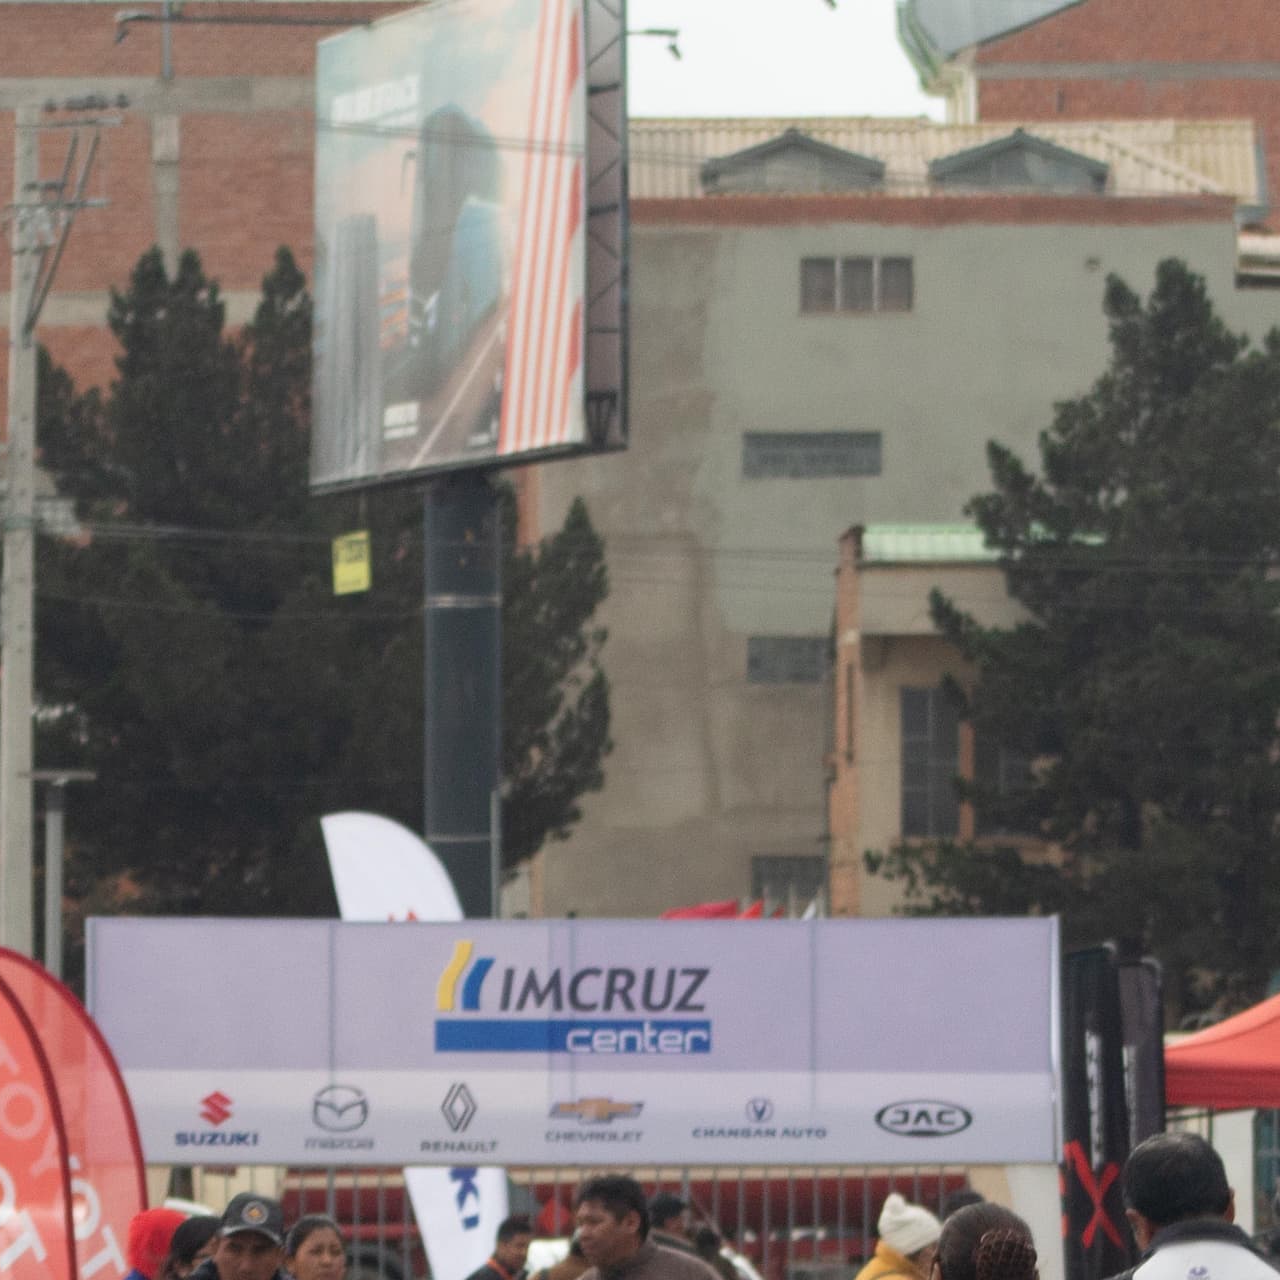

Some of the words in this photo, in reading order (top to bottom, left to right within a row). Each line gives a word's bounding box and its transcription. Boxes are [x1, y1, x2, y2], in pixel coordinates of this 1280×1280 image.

[500, 967, 710, 1012] IMCRUZ
[566, 1021, 708, 1054] center
[889, 1108, 956, 1126] JAC
[174, 1131, 259, 1147] SUZUKI
[545, 1129, 644, 1144] CHEVROLET
[691, 1127, 774, 1139] CHANGAN
[780, 1127, 828, 1138] AUTO
[419, 1140, 499, 1153] RENAULT
